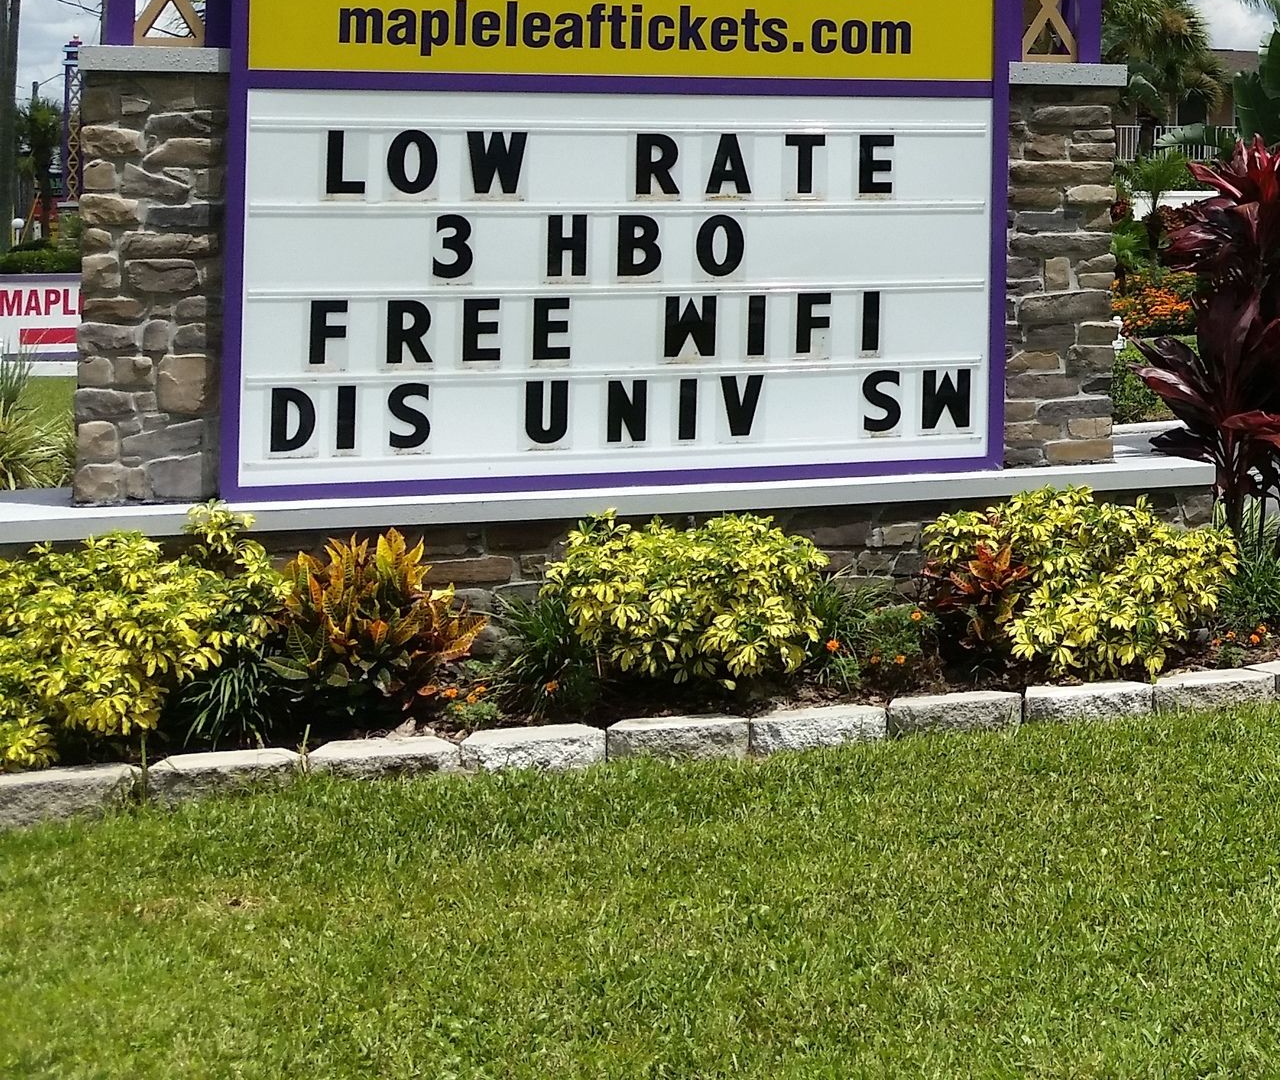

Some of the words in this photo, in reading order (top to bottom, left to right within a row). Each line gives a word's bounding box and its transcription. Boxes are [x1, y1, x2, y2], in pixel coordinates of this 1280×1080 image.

[338, 0, 912, 57] mapleleaftickets.com
[325, 129, 529, 195] LOW
[635, 133, 895, 195] RATE
[432, 213, 474, 279] 3
[546, 213, 745, 277] HBO
[308, 297, 571, 365] FREE
[663, 290, 881, 358] WIFI
[270, 382, 431, 453] DIS
[524, 374, 765, 444] UNIV
[862, 368, 972, 433] SW
